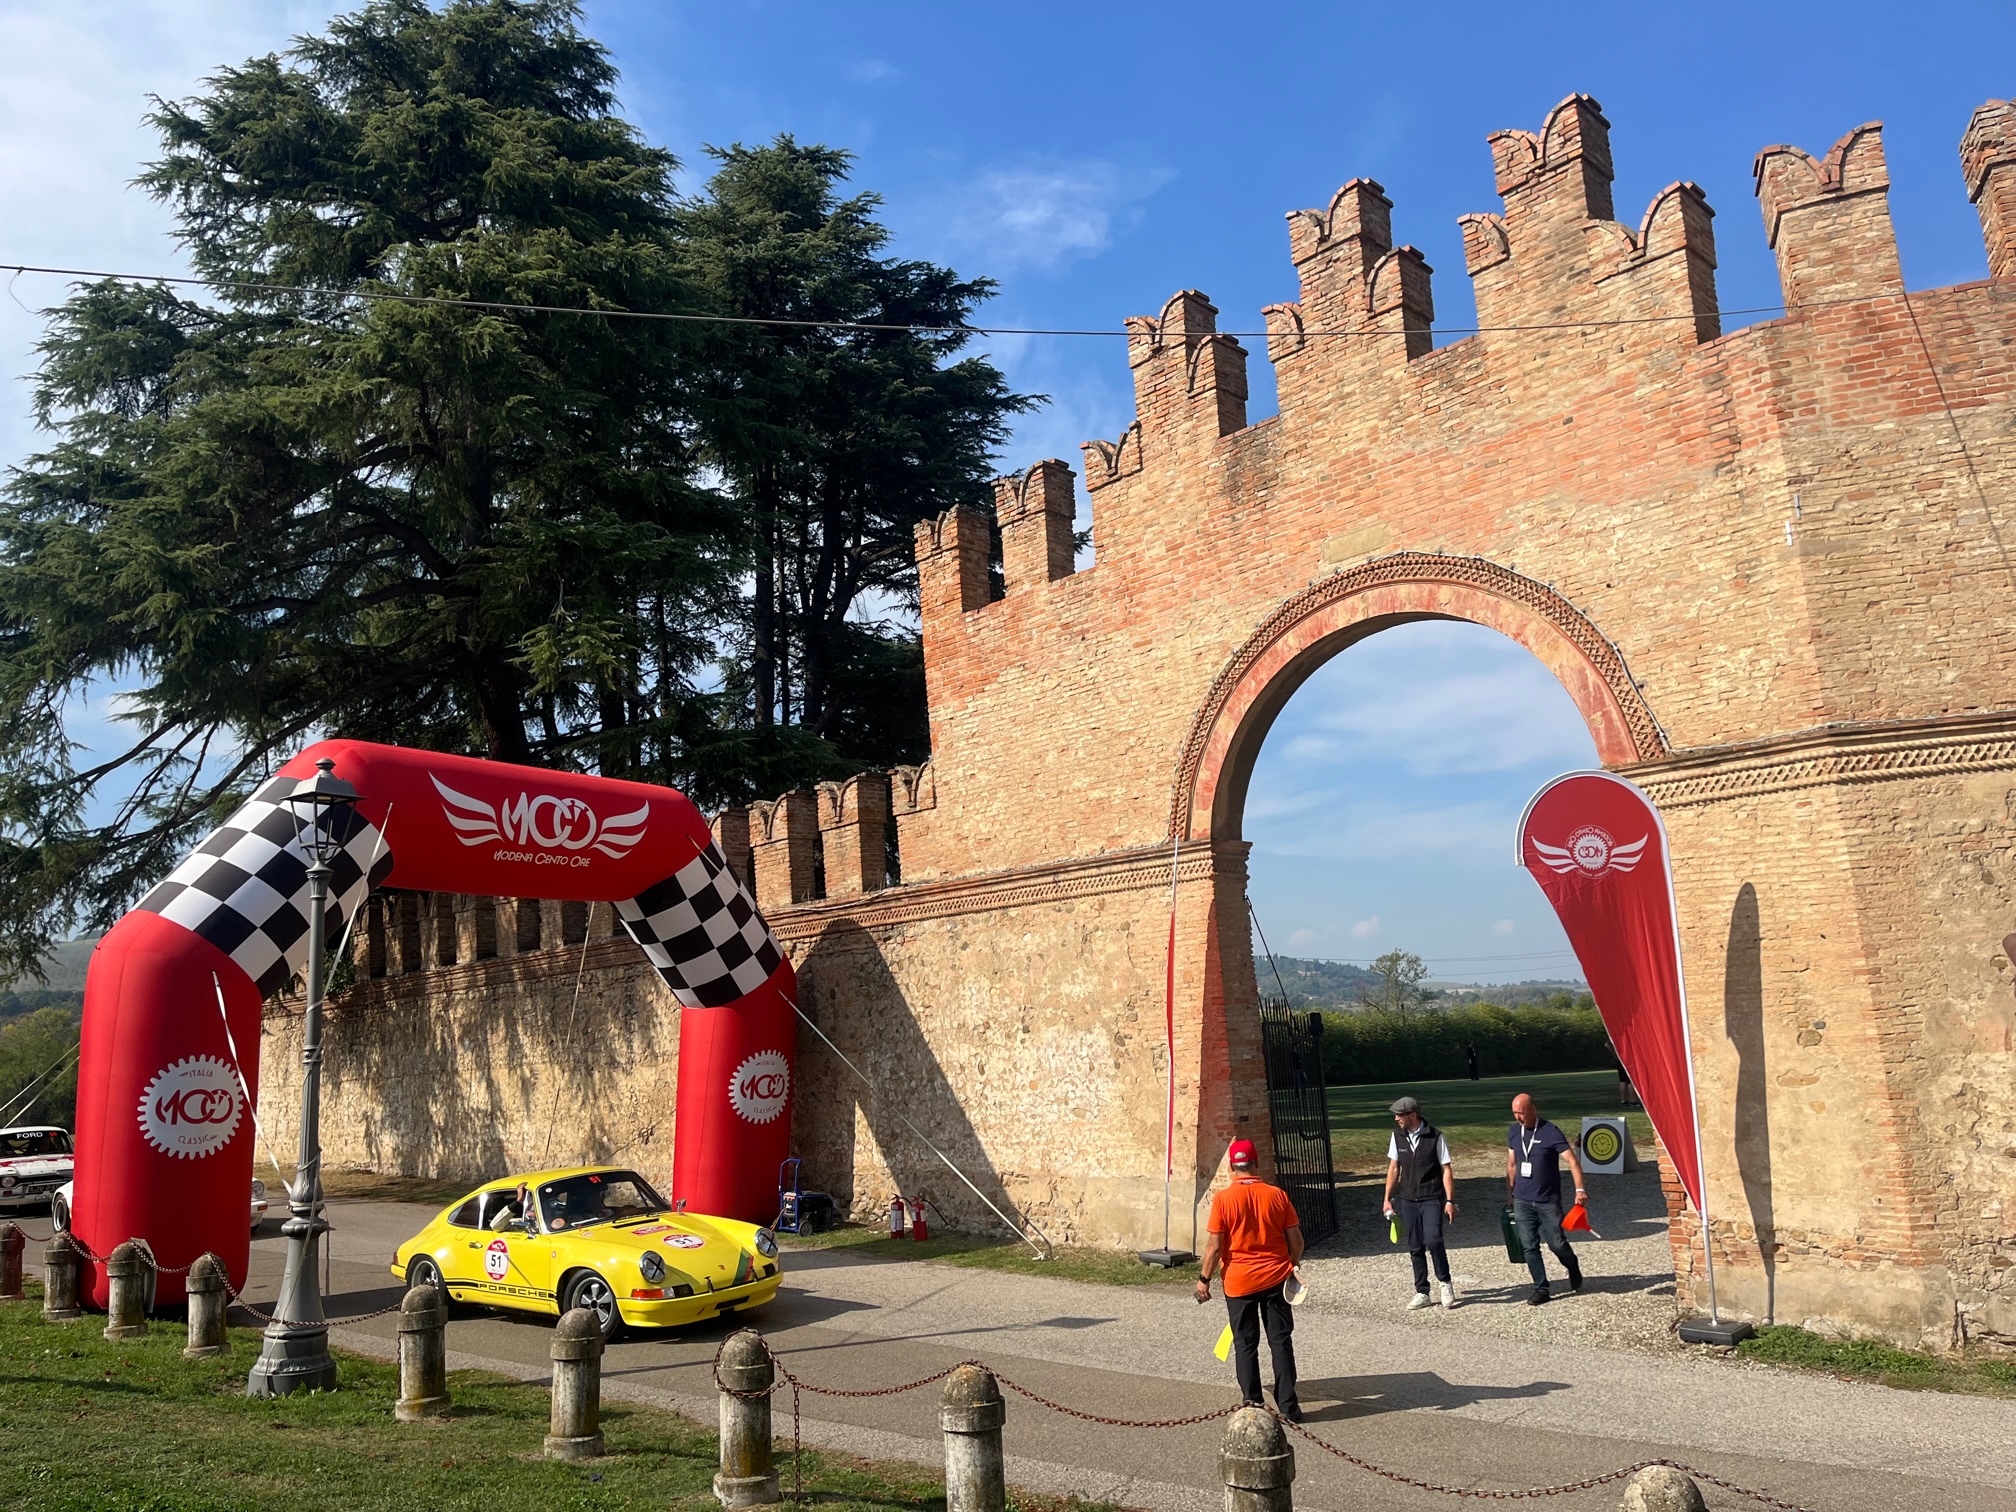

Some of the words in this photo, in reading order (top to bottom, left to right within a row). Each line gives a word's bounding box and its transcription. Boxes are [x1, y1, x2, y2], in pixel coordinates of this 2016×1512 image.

[493, 849, 534, 862] MODENA
[534, 852, 569, 865] CENTO
[570, 855, 592, 868] ORE
[188, 1069, 214, 1078] ITALIA
[754, 1105, 774, 1114] CLASSIC
[16, 1131, 43, 1139] FORD
[178, 1134, 211, 1145] CLASSIC
[588, 1175, 602, 1184] 51
[675, 1237, 693, 1245] 51
[490, 1254, 502, 1268] 51
[479, 1283, 548, 1298] PORSCHE
